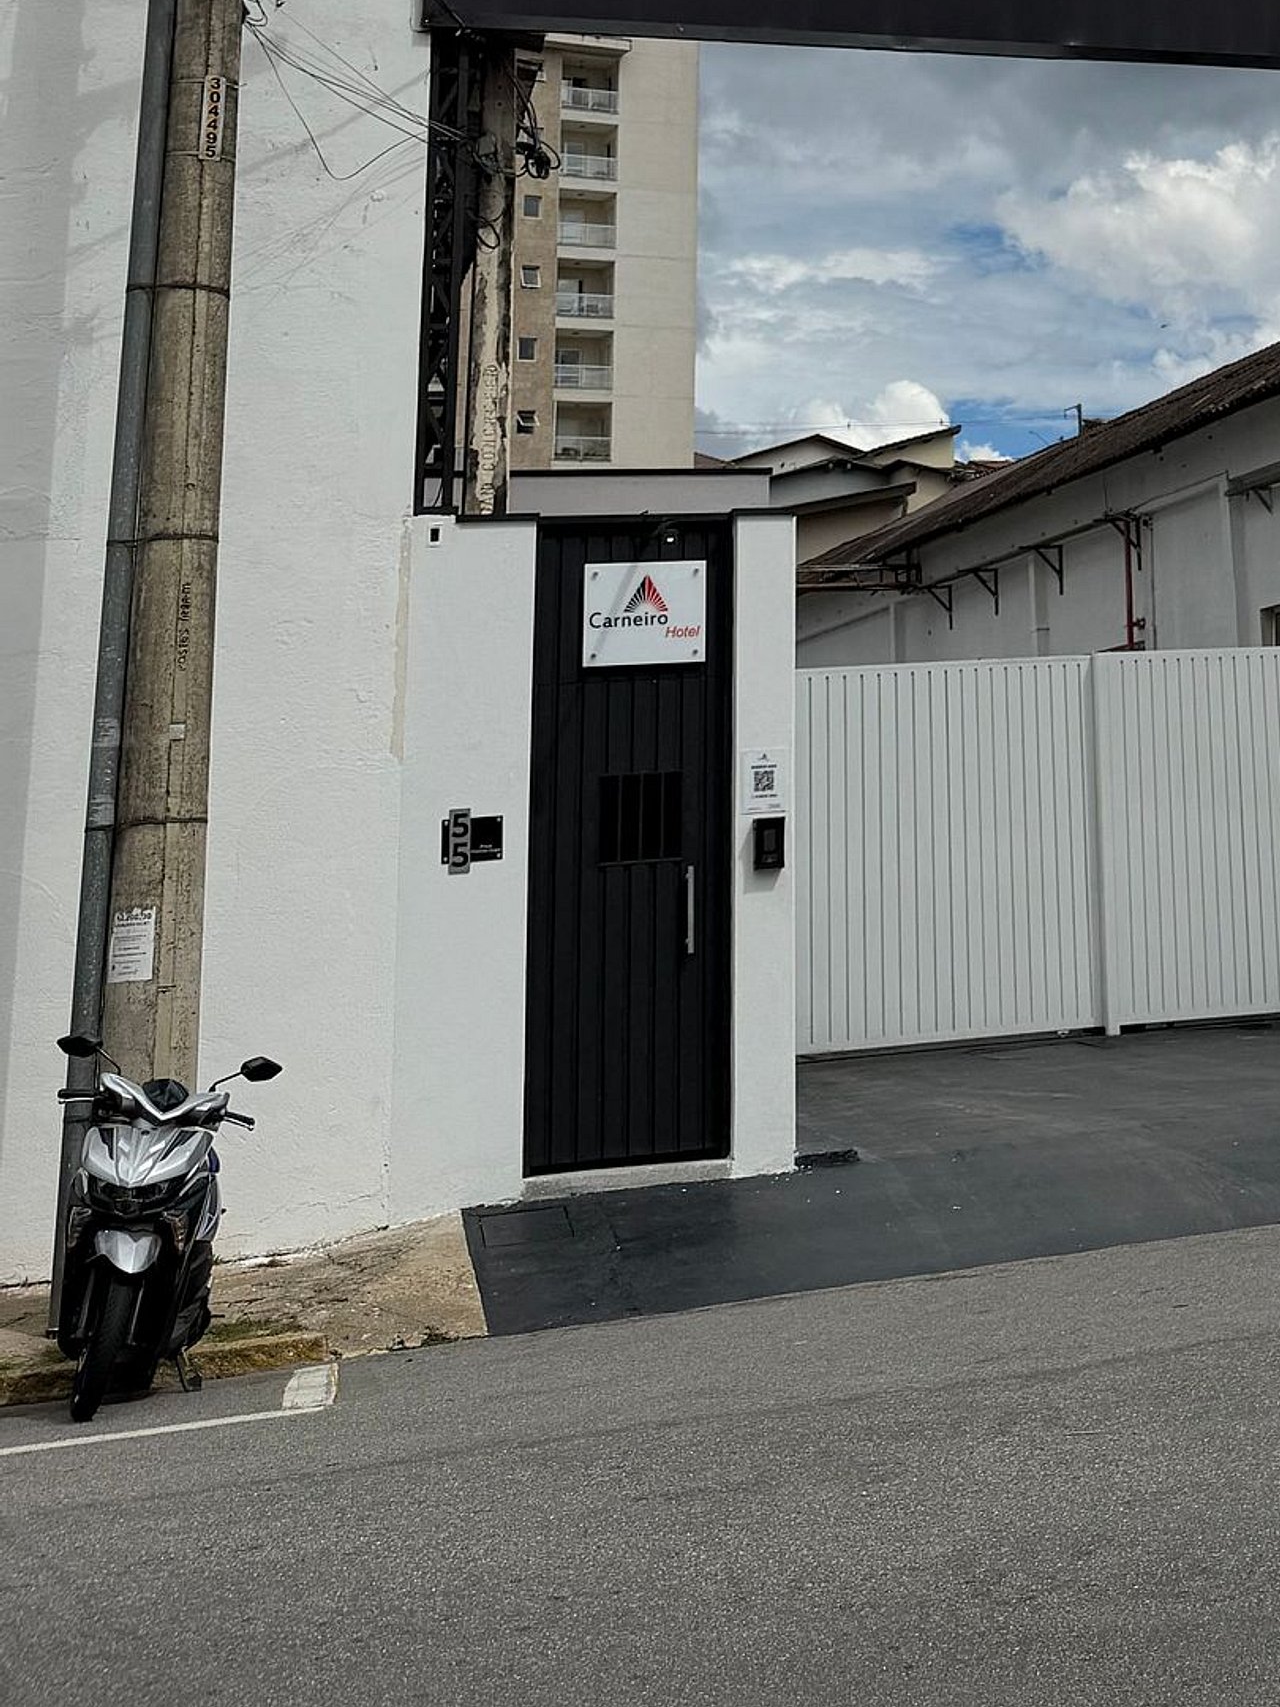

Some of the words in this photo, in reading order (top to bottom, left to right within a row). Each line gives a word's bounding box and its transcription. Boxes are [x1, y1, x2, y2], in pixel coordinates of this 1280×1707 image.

[205, 77, 221, 159] 304495
[589, 611, 669, 629] Carneiro
[665, 625, 701, 638] Hotel
[451, 812, 469, 868] 55
